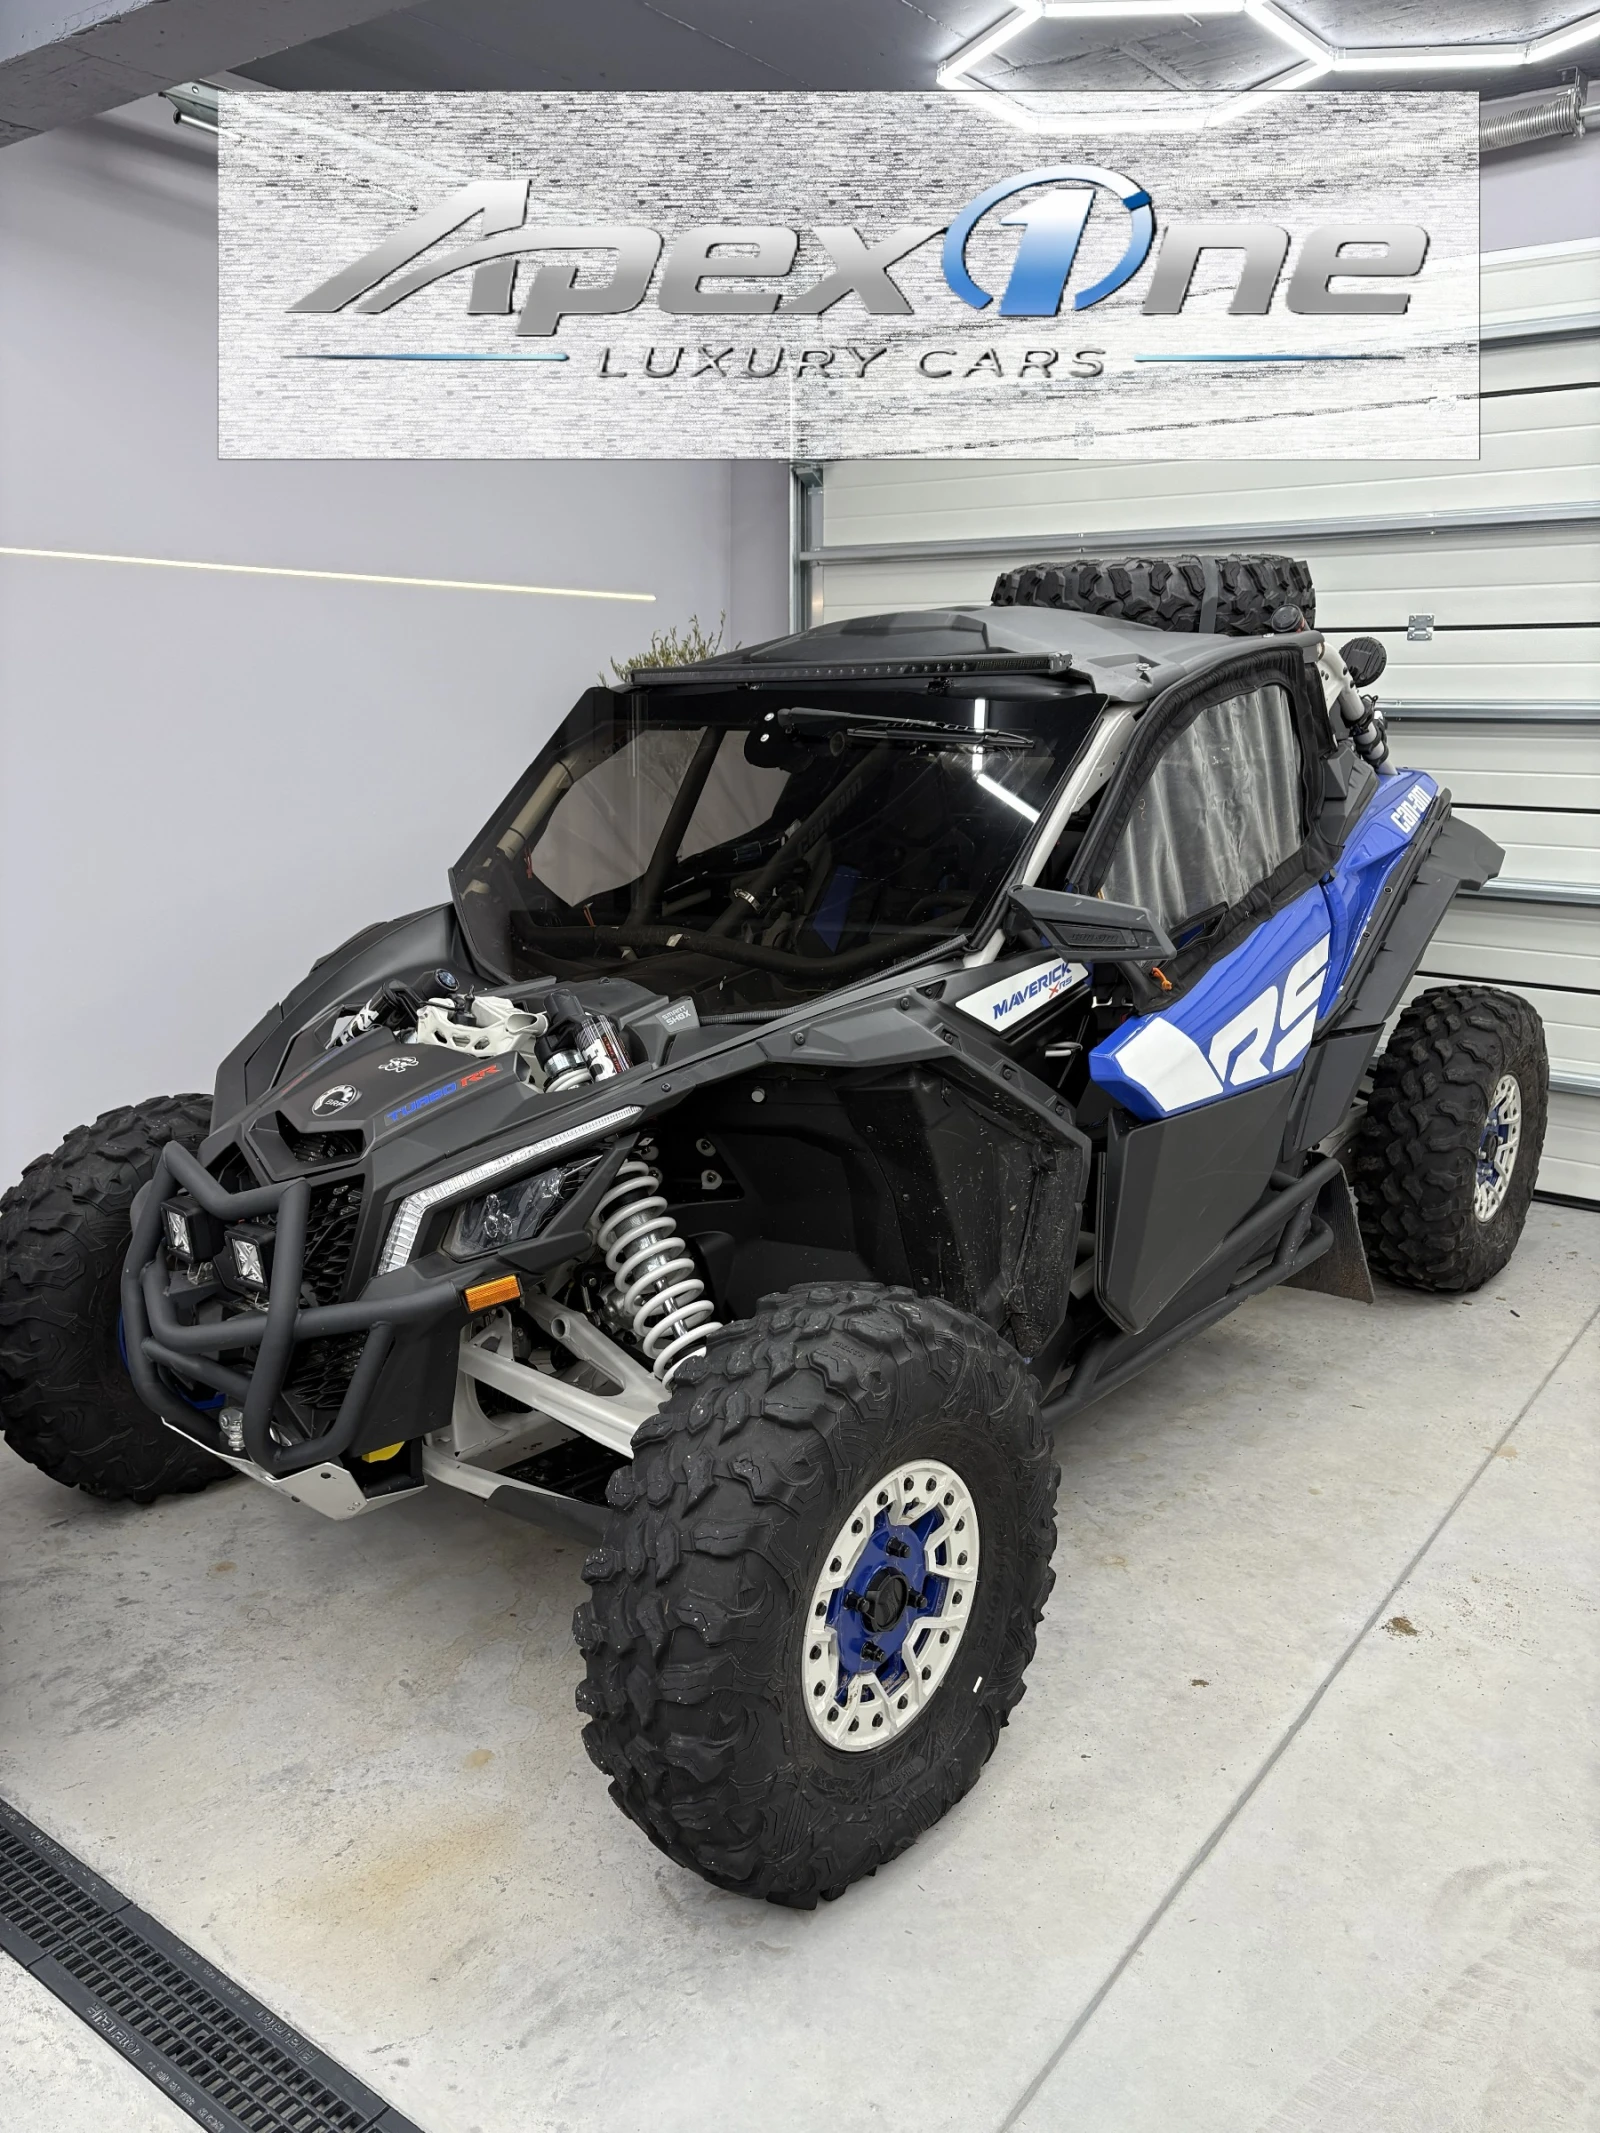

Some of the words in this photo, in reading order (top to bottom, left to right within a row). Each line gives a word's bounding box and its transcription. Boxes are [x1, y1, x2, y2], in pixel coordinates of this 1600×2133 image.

[1390, 784, 1433, 834] can-am
[661, 1004, 687, 1020] SMART
[992, 962, 1072, 1020] MAVERICK
[1208, 932, 1331, 1087] RS
[324, 1098, 348, 1108] BRP
[386, 1081, 458, 1122] TURBO
[460, 1064, 501, 1088] RR
